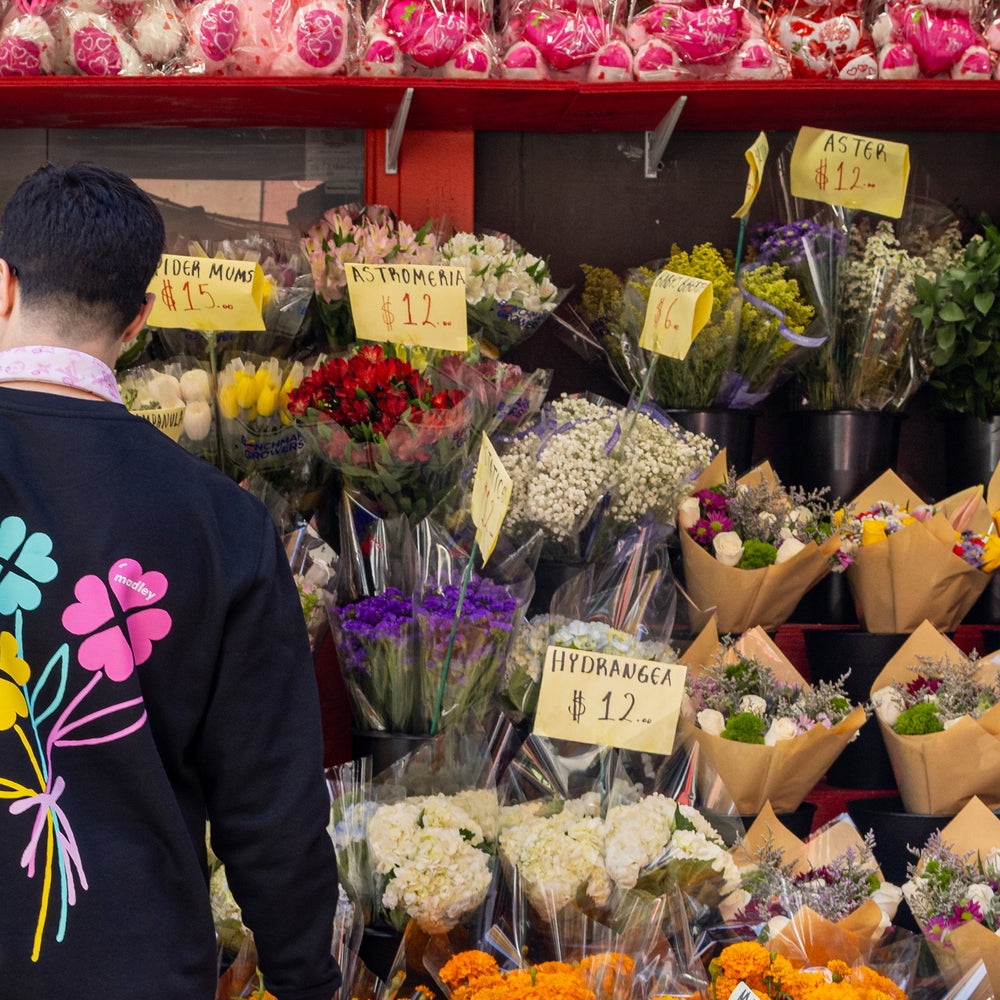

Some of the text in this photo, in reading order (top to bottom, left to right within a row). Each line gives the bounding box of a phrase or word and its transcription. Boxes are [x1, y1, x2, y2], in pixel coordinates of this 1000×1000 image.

[823, 133, 887, 163] ASTER
[155, 258, 255, 284] PIDER MUMS
[352, 266, 466, 288] ASTROMERIA
[552, 649, 672, 687] HYDRANGEA
